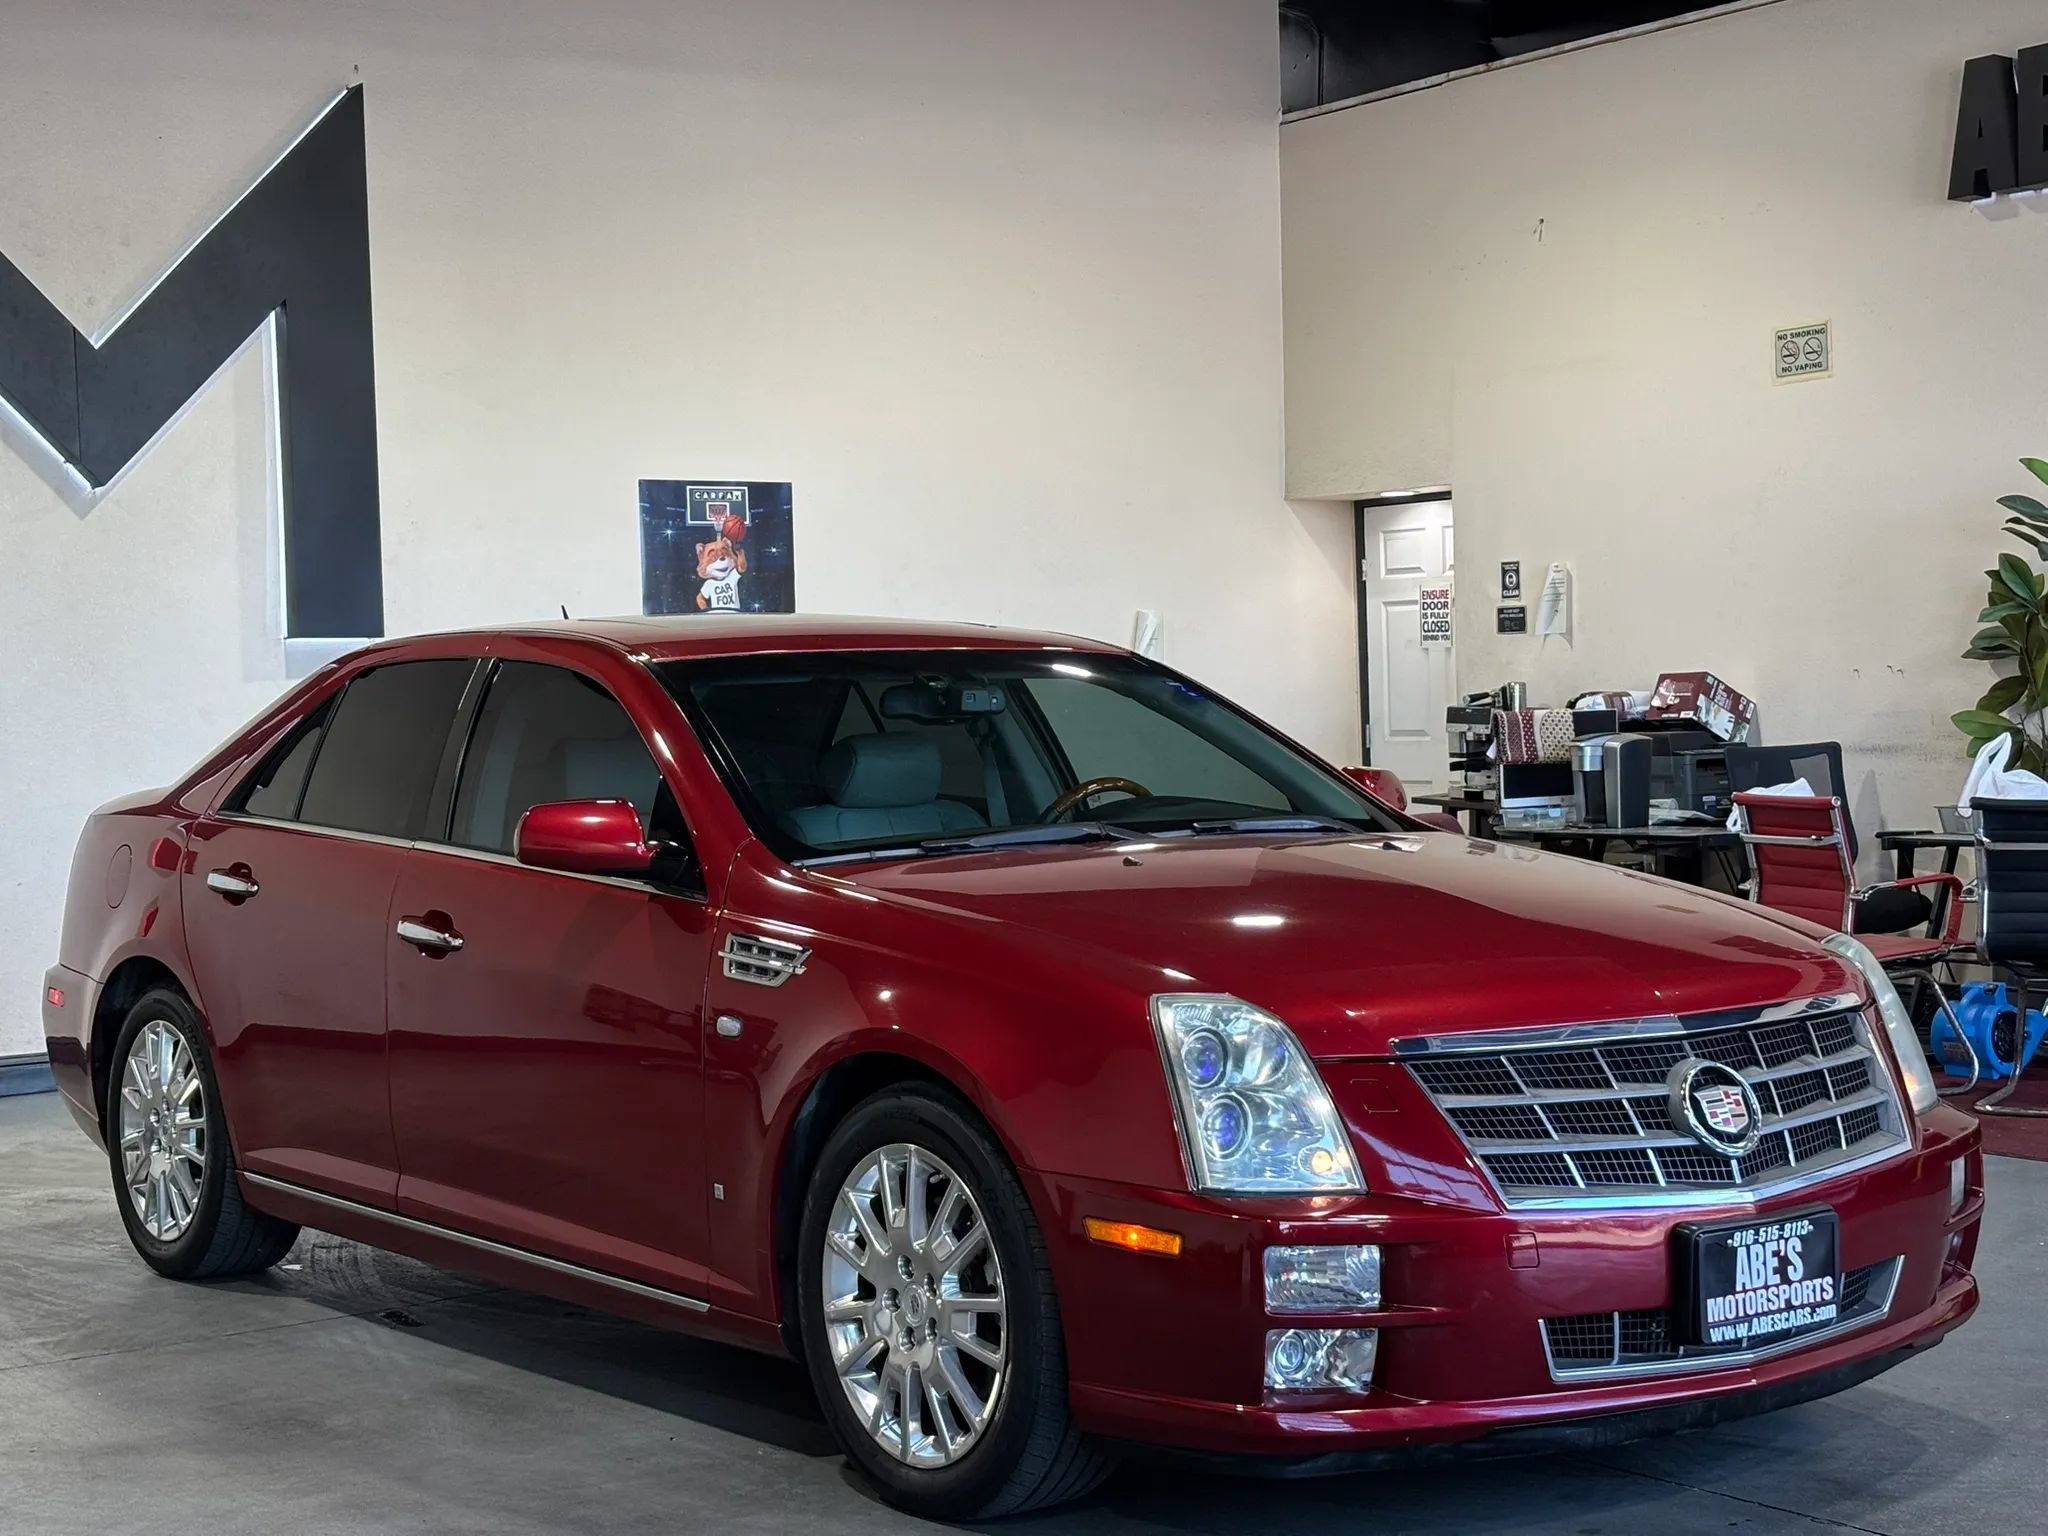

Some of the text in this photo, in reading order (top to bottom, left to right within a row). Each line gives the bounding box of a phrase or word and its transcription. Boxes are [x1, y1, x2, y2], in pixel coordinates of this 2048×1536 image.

[1777, 327, 1826, 342] NO SMOKING
[1781, 361, 1823, 374] NO VAPING
[693, 490, 742, 501] CARFAX
[714, 582, 733, 596] CAR
[1422, 590, 1450, 600] ENSURE
[716, 594, 735, 606] FOX
[1422, 601, 1449, 611] DOOR
[1422, 611, 1450, 620] IS FULLY
[1422, 620, 1450, 633] CLOSED
[1440, 633, 1451, 641] YOU
[1732, 1219, 1809, 1247] 916-515-8113
[1735, 1237, 1804, 1292] ABE'S
[1707, 1276, 1834, 1323] MOTORSPORTS
